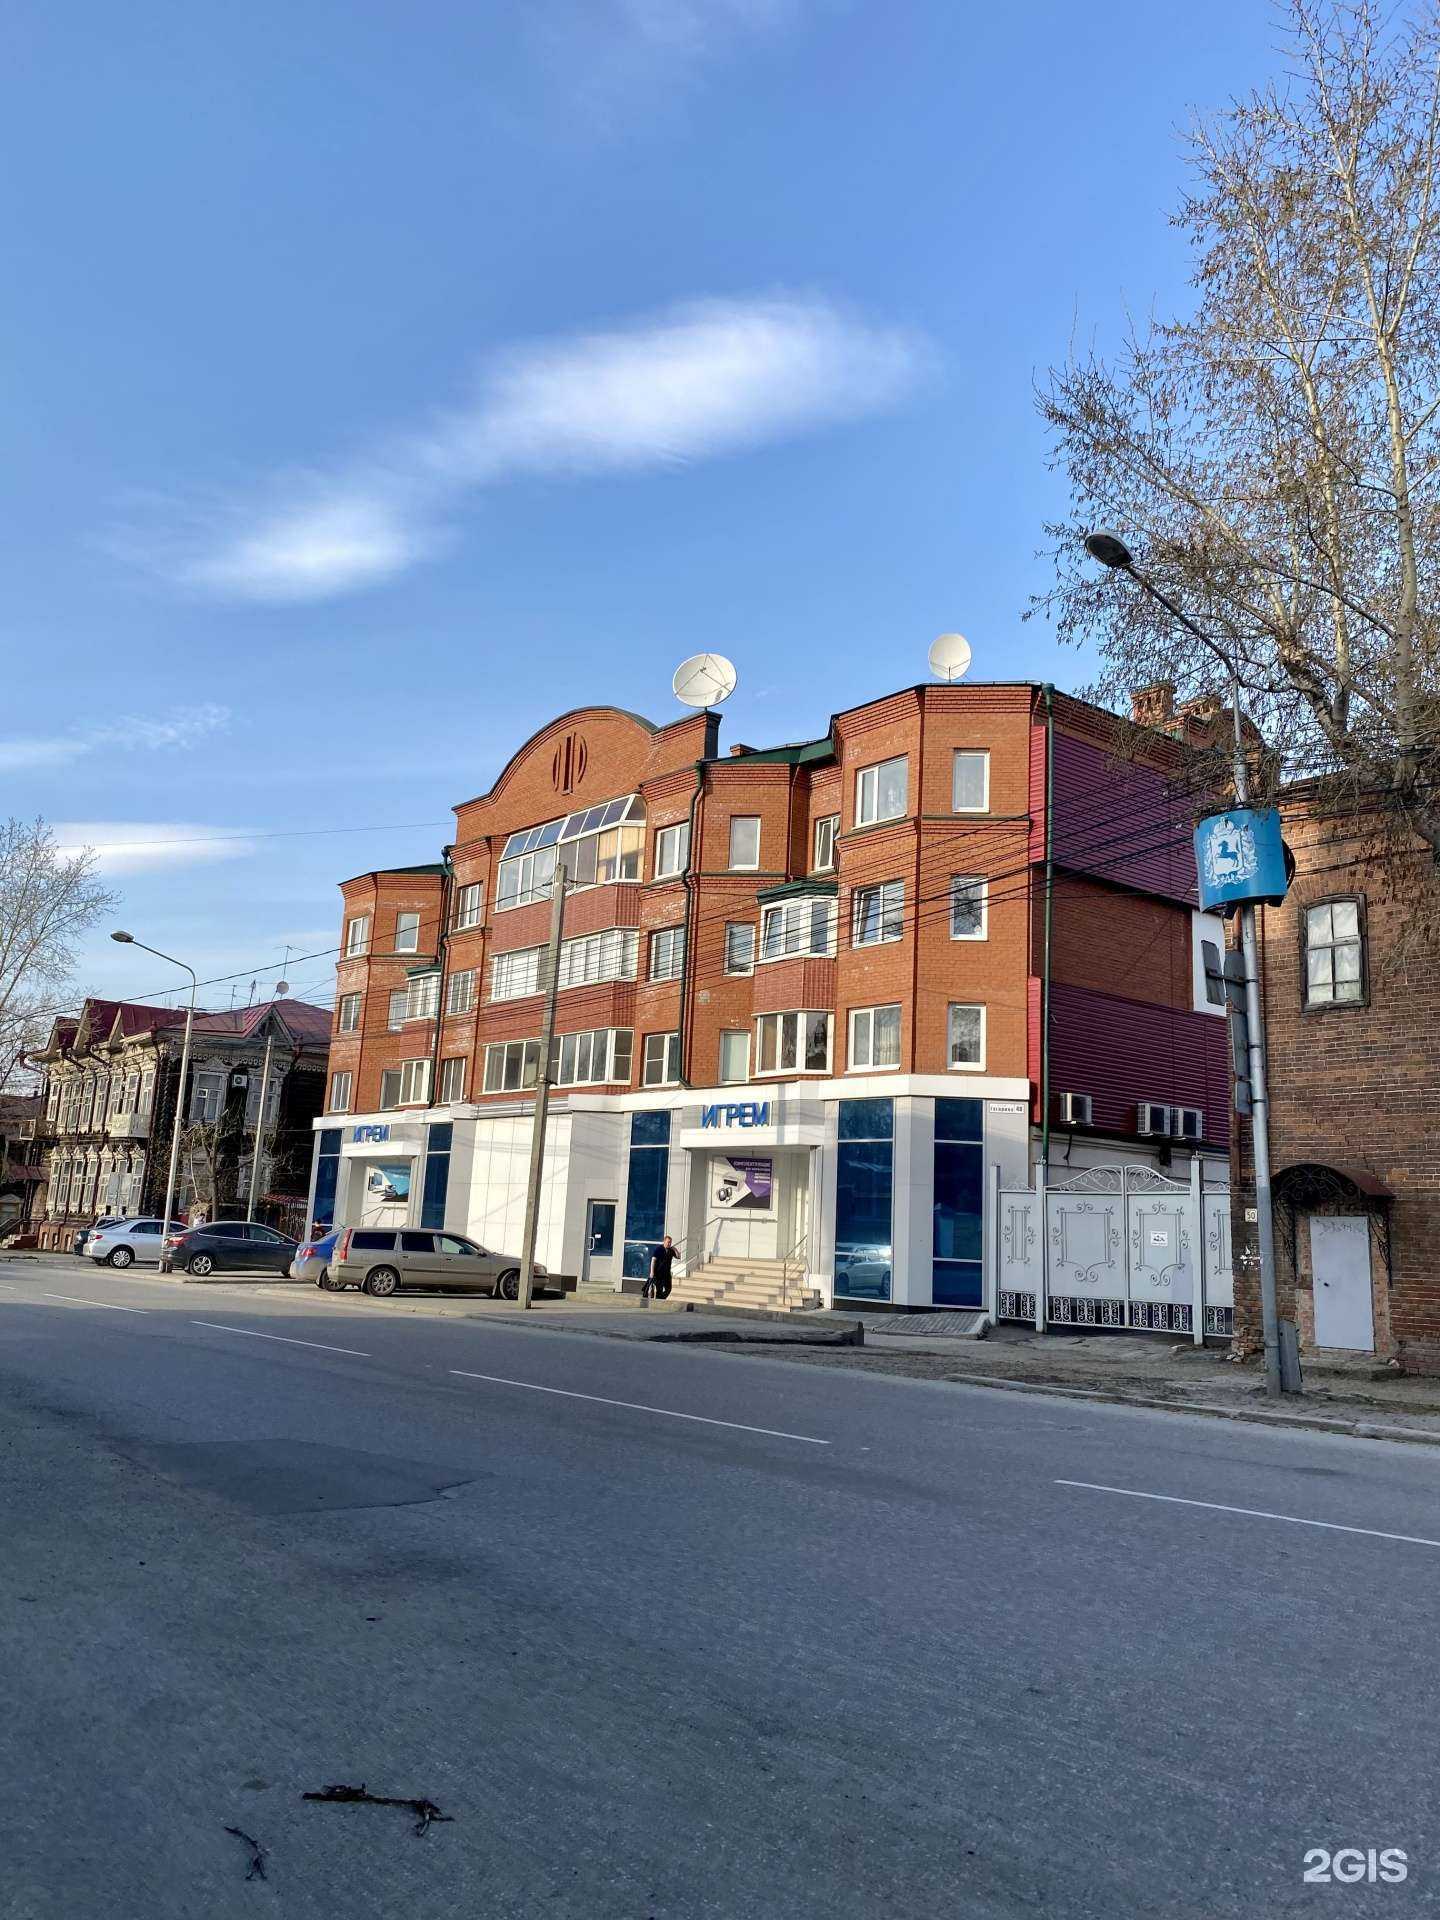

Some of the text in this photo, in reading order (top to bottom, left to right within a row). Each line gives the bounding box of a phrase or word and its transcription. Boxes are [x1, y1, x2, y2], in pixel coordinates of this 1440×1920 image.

[702, 1102, 769, 1128] ИГРЕМ
[353, 1125, 390, 1143] ИГРЕМ
[1247, 1209, 1256, 1219] 50
